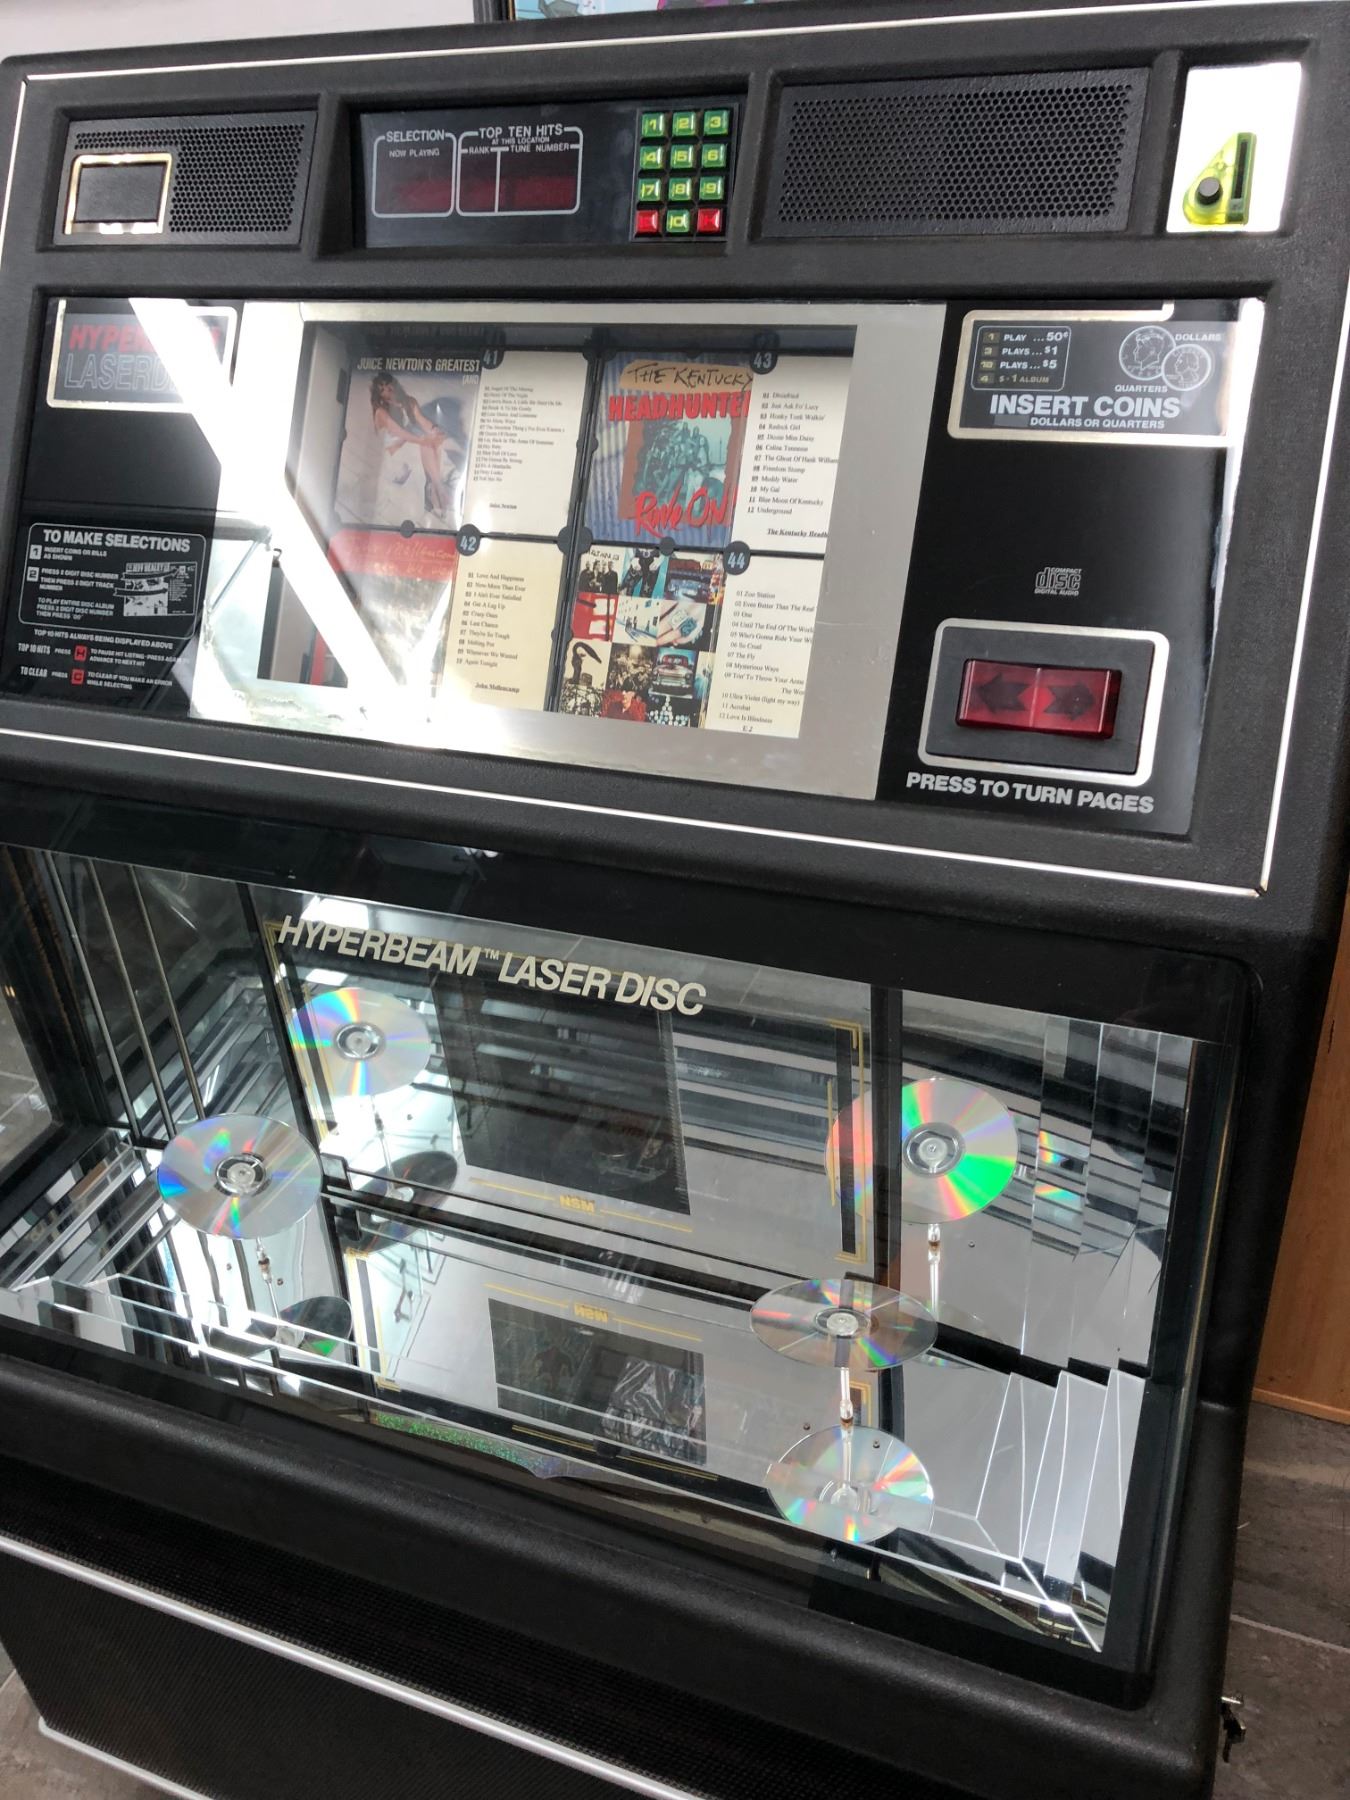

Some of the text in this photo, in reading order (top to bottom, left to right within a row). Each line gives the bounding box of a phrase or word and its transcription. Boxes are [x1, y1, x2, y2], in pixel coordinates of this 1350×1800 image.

[710, 116, 721, 128] 3
[386, 129, 445, 143] SELECTION
[479, 124, 563, 139] TOP TEN HITS
[501, 137, 516, 145] THIS
[517, 136, 550, 144] LOCATION
[389, 148, 440, 158] NOW PLAYING
[469, 147, 490, 155] RANK
[511, 143, 570, 153] TUNE NUMBER
[707, 149, 719, 160] 6
[675, 184, 686, 194] 8
[706, 183, 717, 193] 9
[1003, 333, 1027, 342] PLAY
[1175, 333, 1222, 342] DOLLARS
[1001, 345, 1058, 356] PLAYS $1
[357, 357, 383, 371] JUICE
[385, 357, 432, 372] NEWTON'S
[483, 350, 498, 366] 41
[753, 352, 772, 369] 43
[999, 359, 1057, 370] PLAYS $5
[64, 353, 178, 391] LASERD
[627, 362, 673, 384] THE
[1019, 376, 1050, 384] ALBUM
[1114, 384, 1168, 394] QUARTERS
[990, 394, 1181, 418] INSERT COINS
[1030, 417, 1165, 430] DOLLARS OR QUARTERS
[43, 529, 191, 552] TO MAKE SELECTIONS
[460, 535, 477, 551] 42
[727, 552, 745, 569] 44
[1035, 567, 1081, 590] disc
[906, 771, 1154, 814] PRESS TO TURN PAGES
[498, 951, 611, 1000] LASER
[615, 971, 707, 1016] DISC
[559, 1193, 595, 1214] NSM
